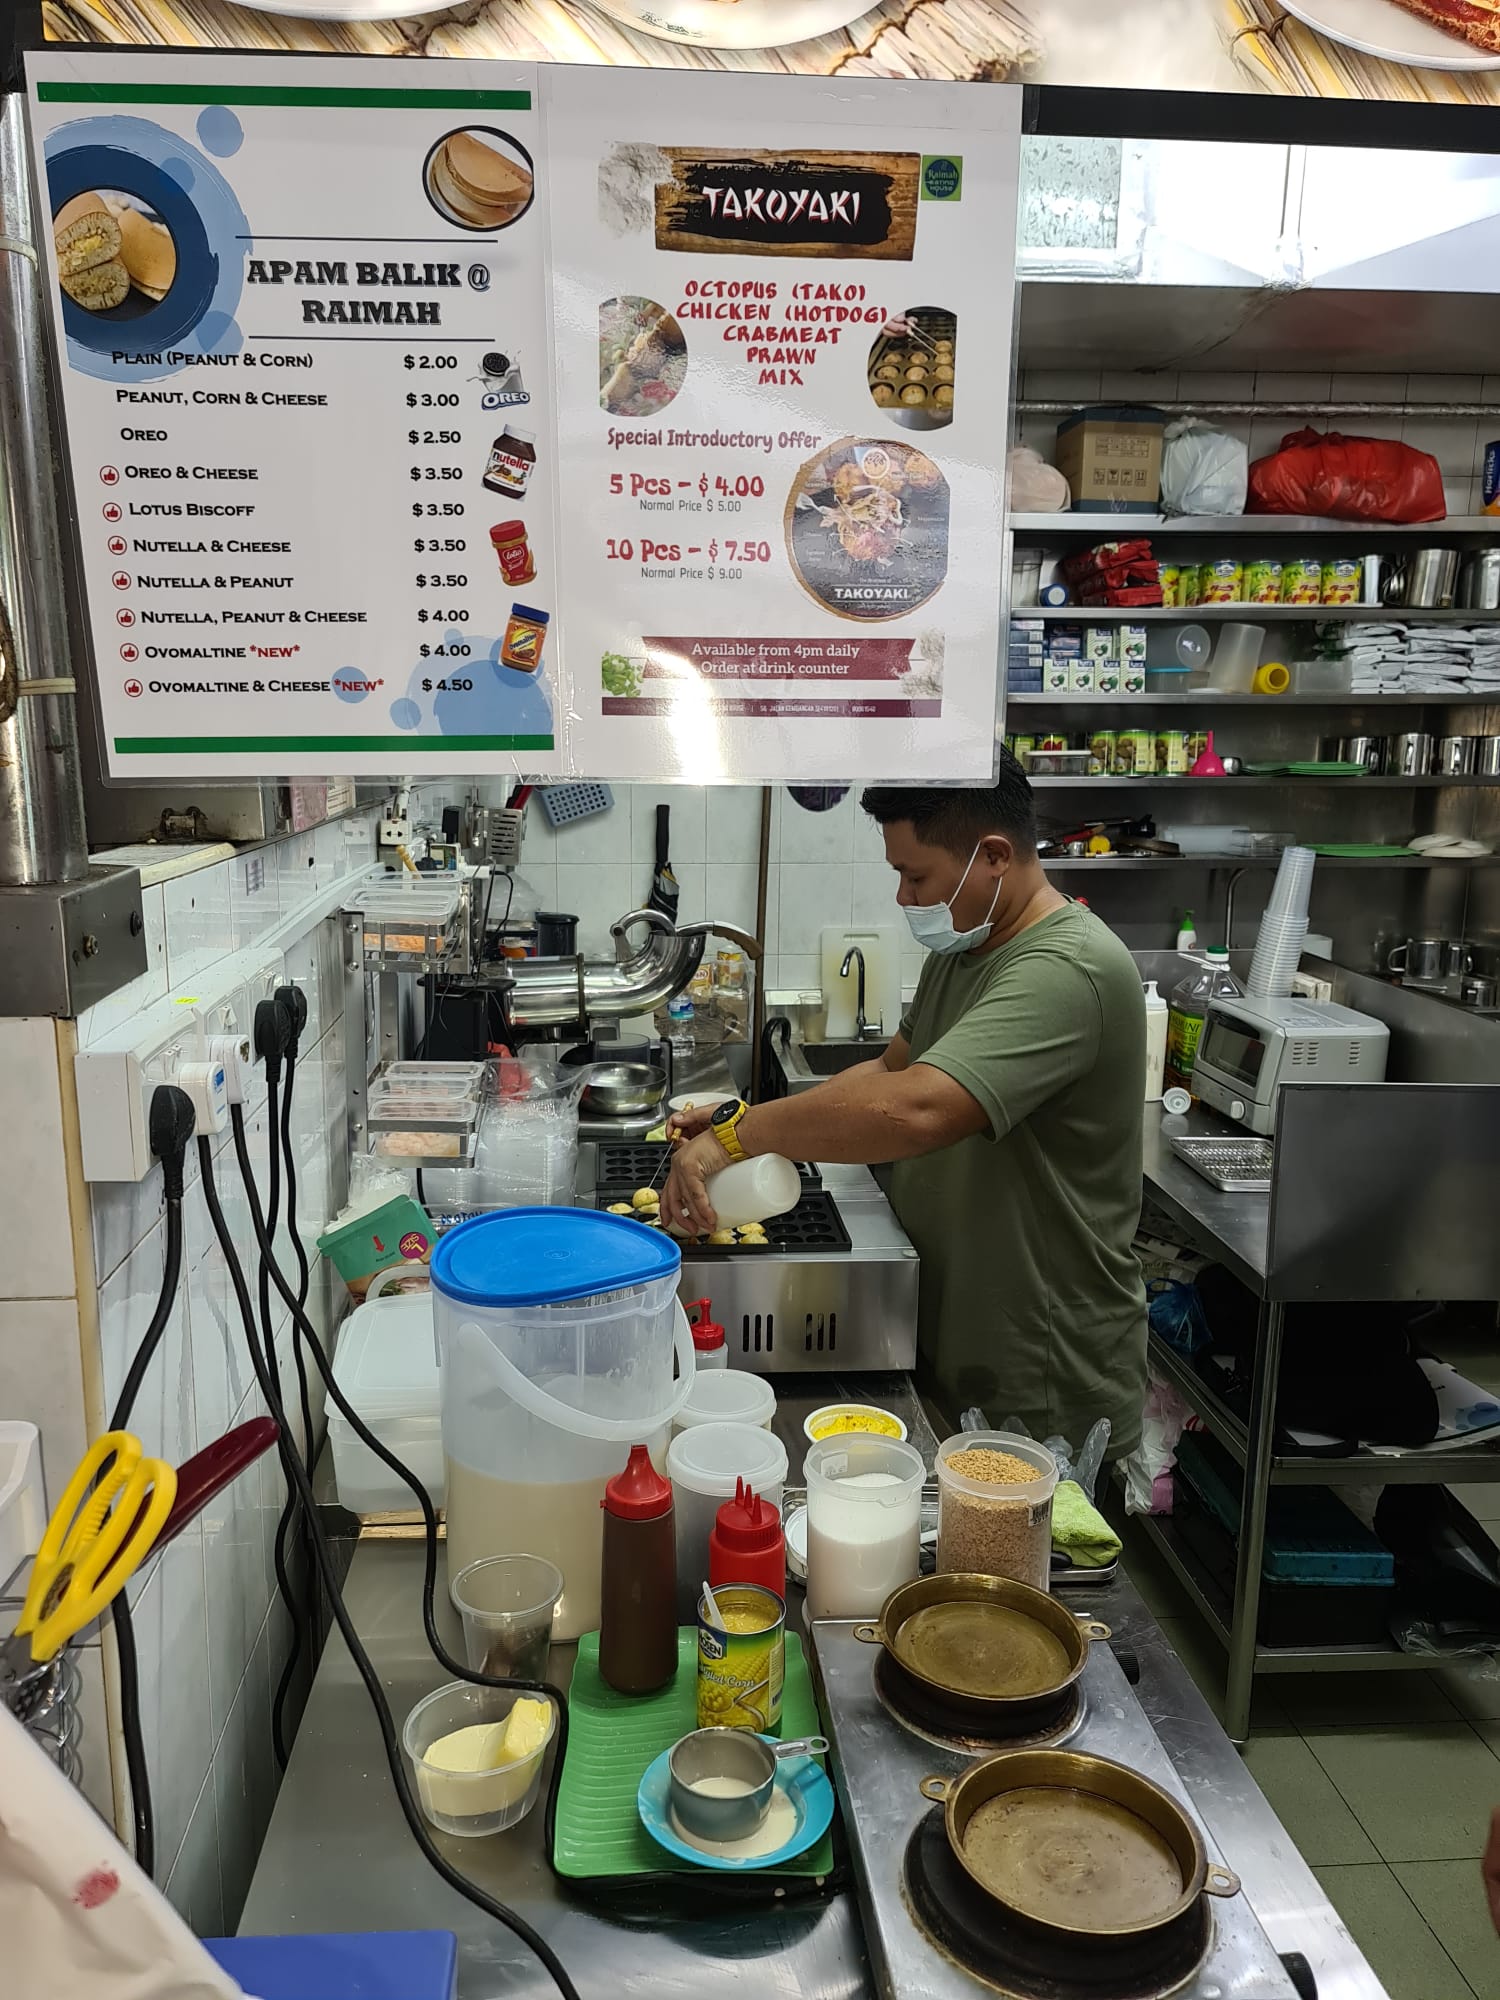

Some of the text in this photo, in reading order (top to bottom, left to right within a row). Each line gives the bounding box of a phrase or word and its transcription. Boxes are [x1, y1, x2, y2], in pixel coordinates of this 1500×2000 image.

[702, 186, 860, 226] TAKOYAKI
[246, 259, 492, 293] APAM BALIK @
[685, 279, 867, 301] OCTOPUS (TAKO)
[301, 300, 441, 326] RAIMAH
[677, 301, 888, 323] CHICKEN (HOTDOG)
[722, 324, 842, 344] CRABMEAT
[243, 352, 257, 367] &
[403, 353, 458, 371] $ 2.00
[746, 348, 817, 365] PRAWN
[758, 369, 804, 386] MIX
[245, 390, 258, 406] &
[406, 392, 460, 409] $ 3.00
[482, 391, 531, 409] OREO
[408, 429, 461, 445] $ 2.50
[607, 427, 822, 454] Special Introductory Offer
[493, 451, 530, 472] nutella
[176, 466, 189, 480] &
[410, 466, 463, 482] $ 3.50
[1485, 450, 1495, 494] Horlicks
[609, 473, 623, 496] 5
[630, 474, 672, 497] Pcs
[698, 473, 708, 498] $
[715, 474, 765, 497] 4.00
[412, 502, 465, 518] $ 3.50
[639, 499, 741, 514] Normal Price $ 5.00
[211, 539, 224, 554] &
[414, 538, 466, 554] $ 3.50
[606, 538, 634, 561] 10
[641, 538, 681, 562] Pcs
[708, 538, 718, 563] $
[724, 539, 771, 562] 7.50
[415, 573, 468, 589] $ 3.50
[641, 566, 743, 580] Normal Price $ 9.00
[214, 575, 227, 590] &
[834, 587, 909, 600] TAKOYAKI
[289, 610, 301, 625] &
[417, 608, 470, 624] $ 4.00
[419, 643, 472, 659] $ 4.00
[692, 643, 860, 660] Available from 4pm daily
[700, 661, 850, 675] Order at drink counter
[252, 680, 265, 694] &
[421, 677, 474, 693] $ 4.50
[728, 1675, 754, 1688] Corn
